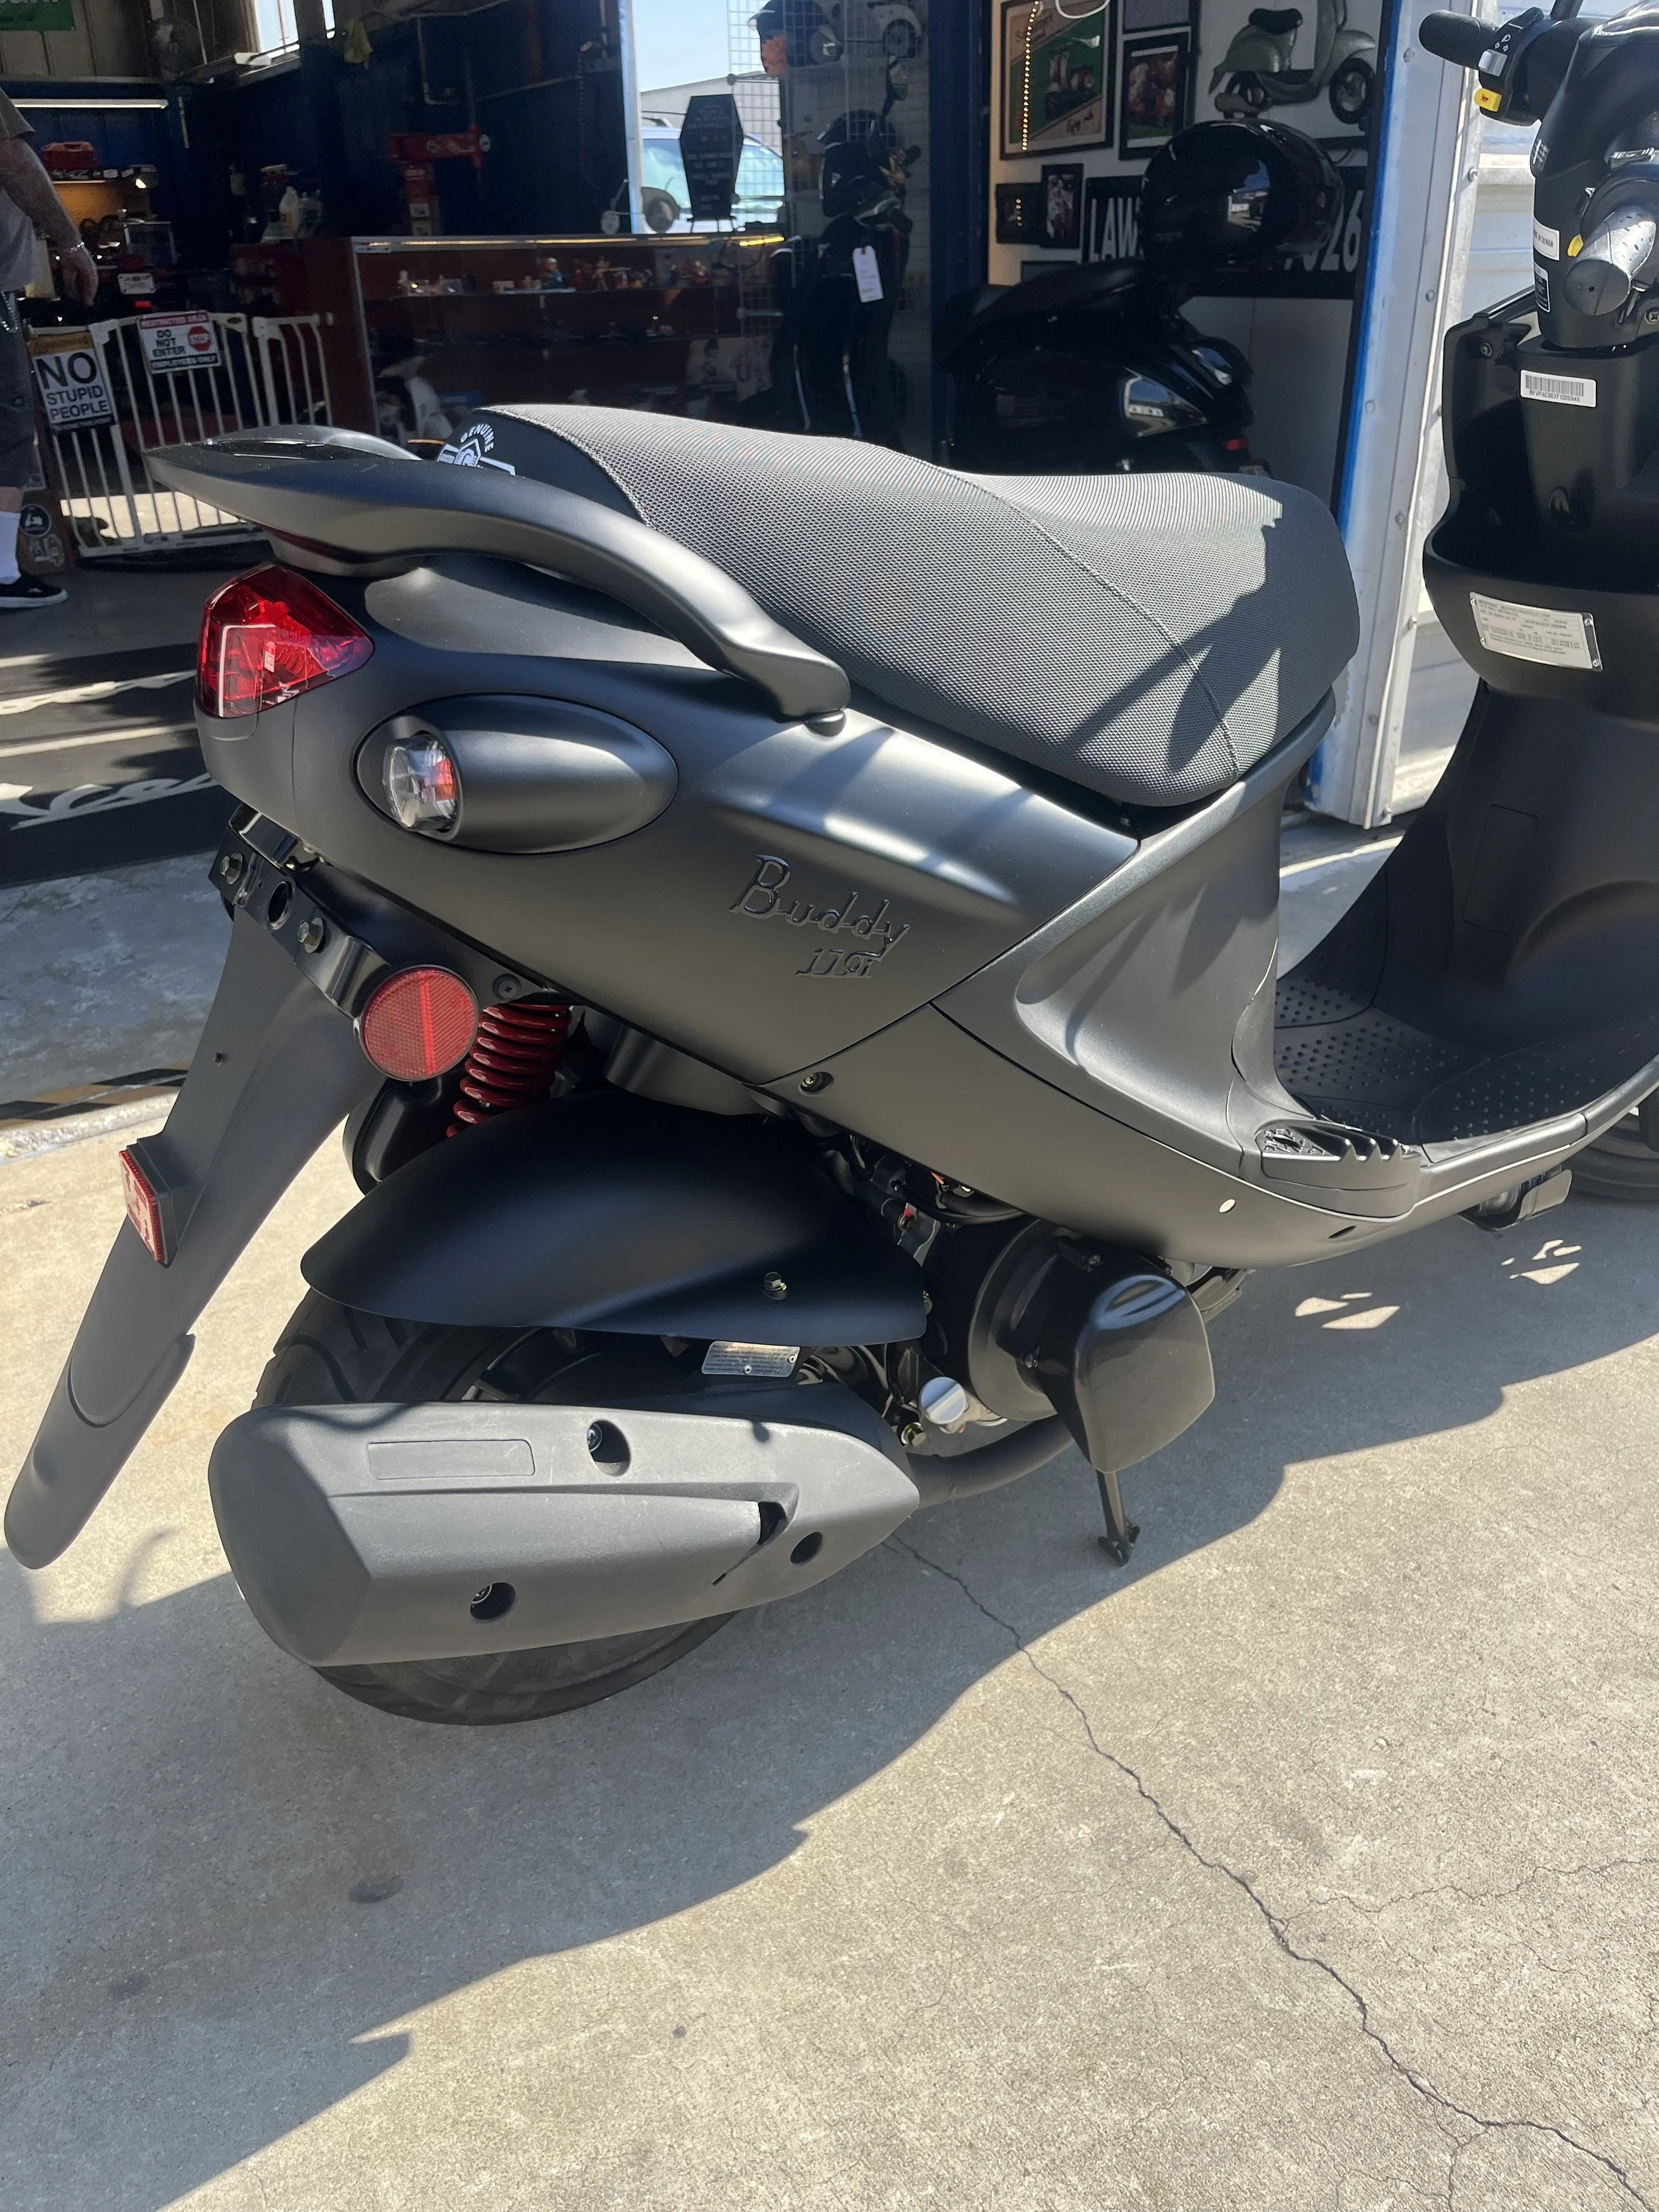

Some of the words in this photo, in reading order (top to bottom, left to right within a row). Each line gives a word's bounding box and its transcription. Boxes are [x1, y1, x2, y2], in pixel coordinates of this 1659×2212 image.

[156, 338, 176, 347] NOT
[157, 329, 172, 338] DO
[152, 346, 186, 358] ENTER
[35, 352, 97, 390] NO
[46, 386, 103, 406] STUPID
[50, 400, 109, 420] PEOPLE
[460, 423, 495, 453] GENUINE
[729, 853, 911, 962] Buddy
